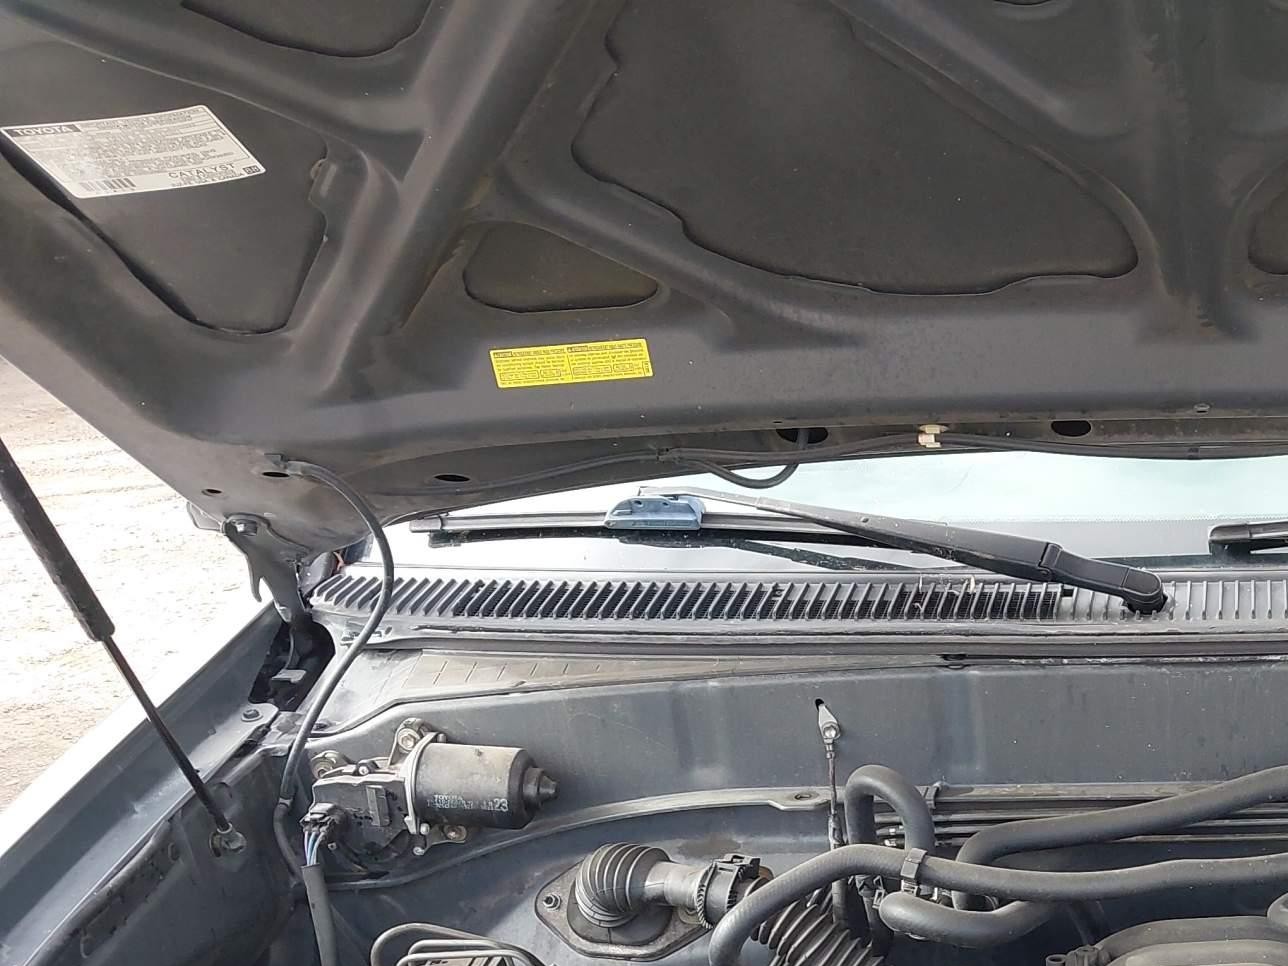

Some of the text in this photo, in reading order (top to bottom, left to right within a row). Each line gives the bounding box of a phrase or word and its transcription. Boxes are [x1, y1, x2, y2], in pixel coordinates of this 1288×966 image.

[12, 125, 73, 136] TOYOTA
[168, 163, 236, 178] CATALYST
[493, 797, 509, 812] 23
